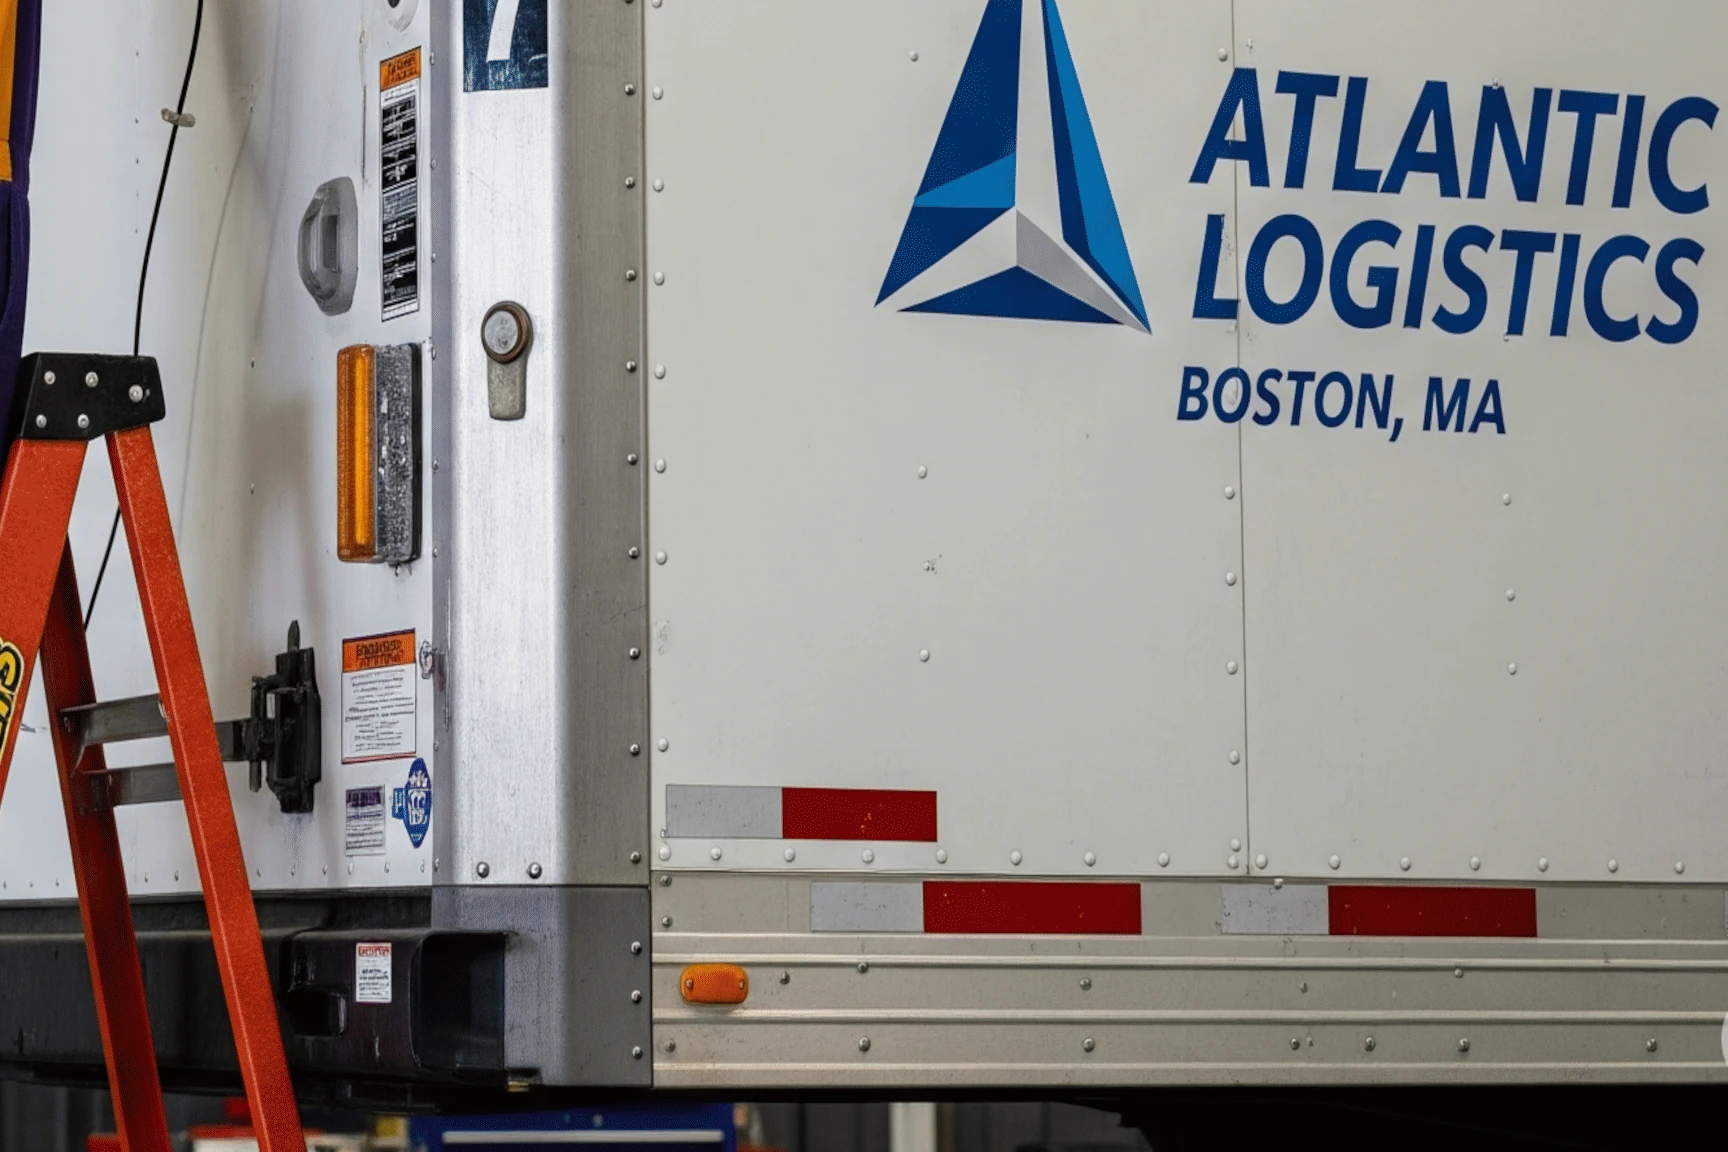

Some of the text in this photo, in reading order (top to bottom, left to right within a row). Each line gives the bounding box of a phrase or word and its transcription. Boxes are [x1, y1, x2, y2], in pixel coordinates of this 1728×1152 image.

[1188, 66, 1720, 214] ATLANTIC
[1191, 212, 1706, 345] LOGISTICS
[1175, 365, 1507, 442] BOSTON, MA
